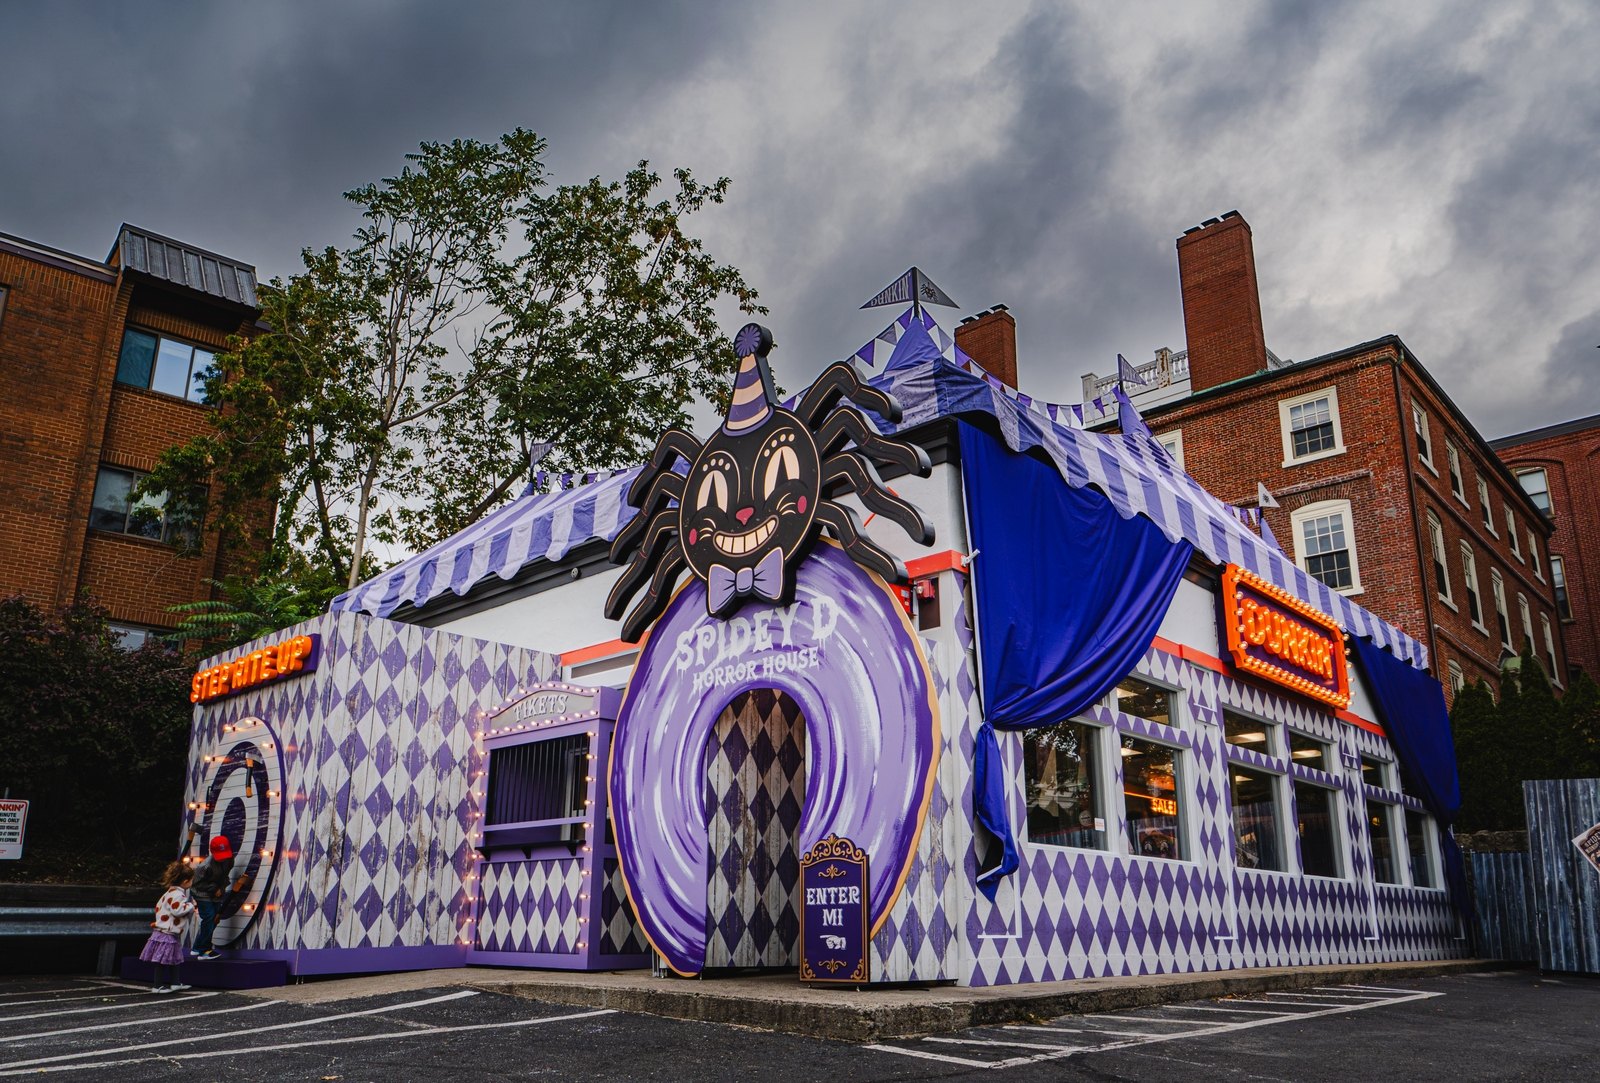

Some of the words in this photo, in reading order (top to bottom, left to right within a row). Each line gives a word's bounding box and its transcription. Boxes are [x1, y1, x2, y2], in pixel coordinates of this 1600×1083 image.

[676, 601, 801, 681] SPIDEY
[811, 595, 839, 655] D
[190, 662, 233, 702] STEP
[232, 645, 278, 689] RITE
[277, 635, 312, 673] UP
[692, 660, 760, 694] HORROR
[762, 646, 820, 680] HOUSE
[513, 696, 569, 722] TIKETS
[806, 886, 860, 905] ENTER
[822, 908, 844, 926] MI
